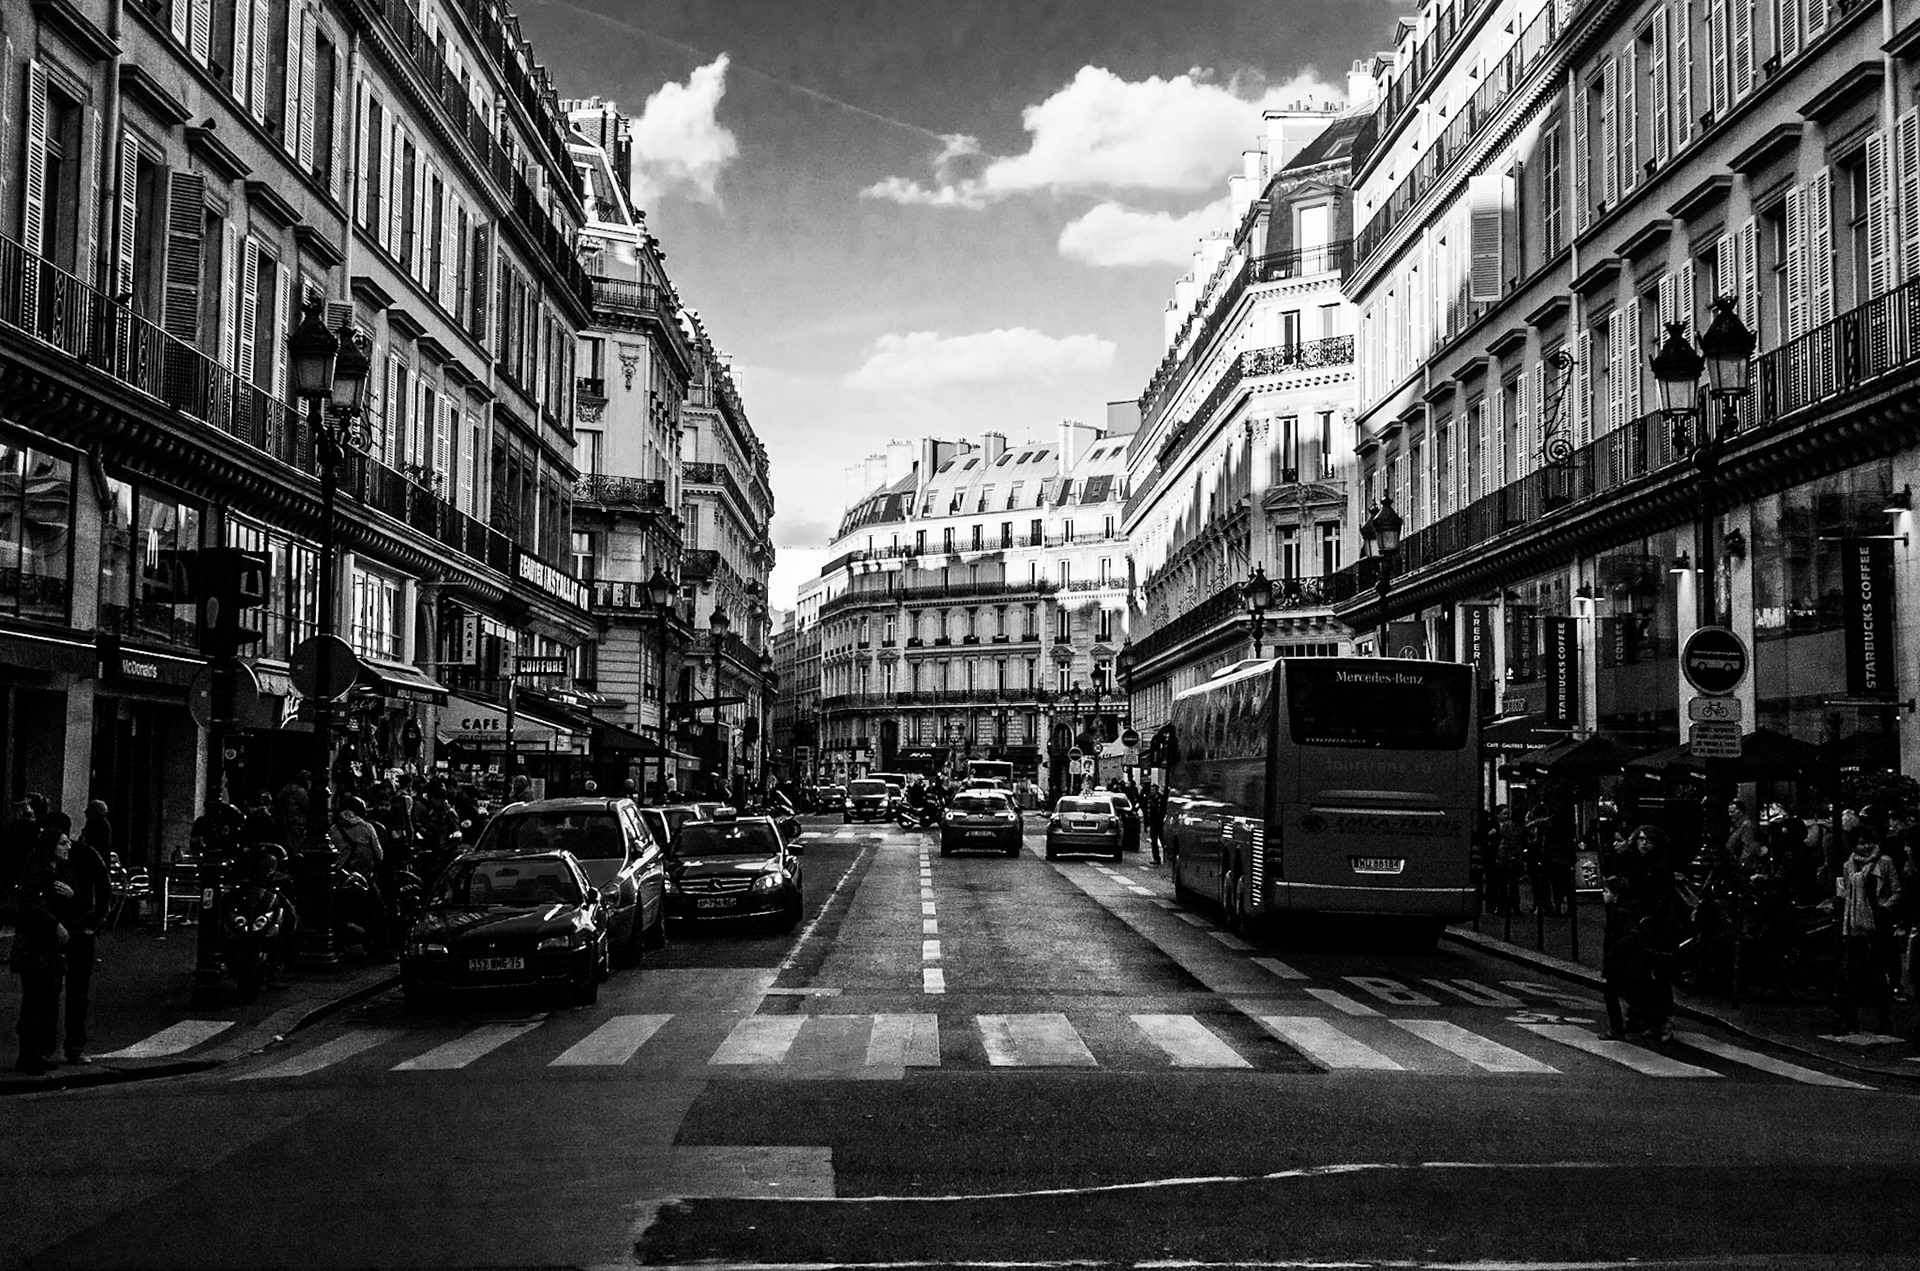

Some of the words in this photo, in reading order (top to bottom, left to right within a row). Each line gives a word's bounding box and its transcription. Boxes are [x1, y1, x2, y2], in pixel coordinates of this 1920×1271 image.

[1859, 546, 1873, 601] COFFEE
[1473, 610, 1481, 671] CREPERI
[1557, 622, 1566, 660] COFFEE
[1862, 603, 1877, 689] STARBUCKS
[520, 660, 564, 673] COIFFURE
[1335, 671, 1424, 685] Mercedes-Benz
[1558, 661, 1567, 720] STARBUCKS
[461, 718, 500, 730] CAFE
[1340, 975, 1607, 1011] BUS
